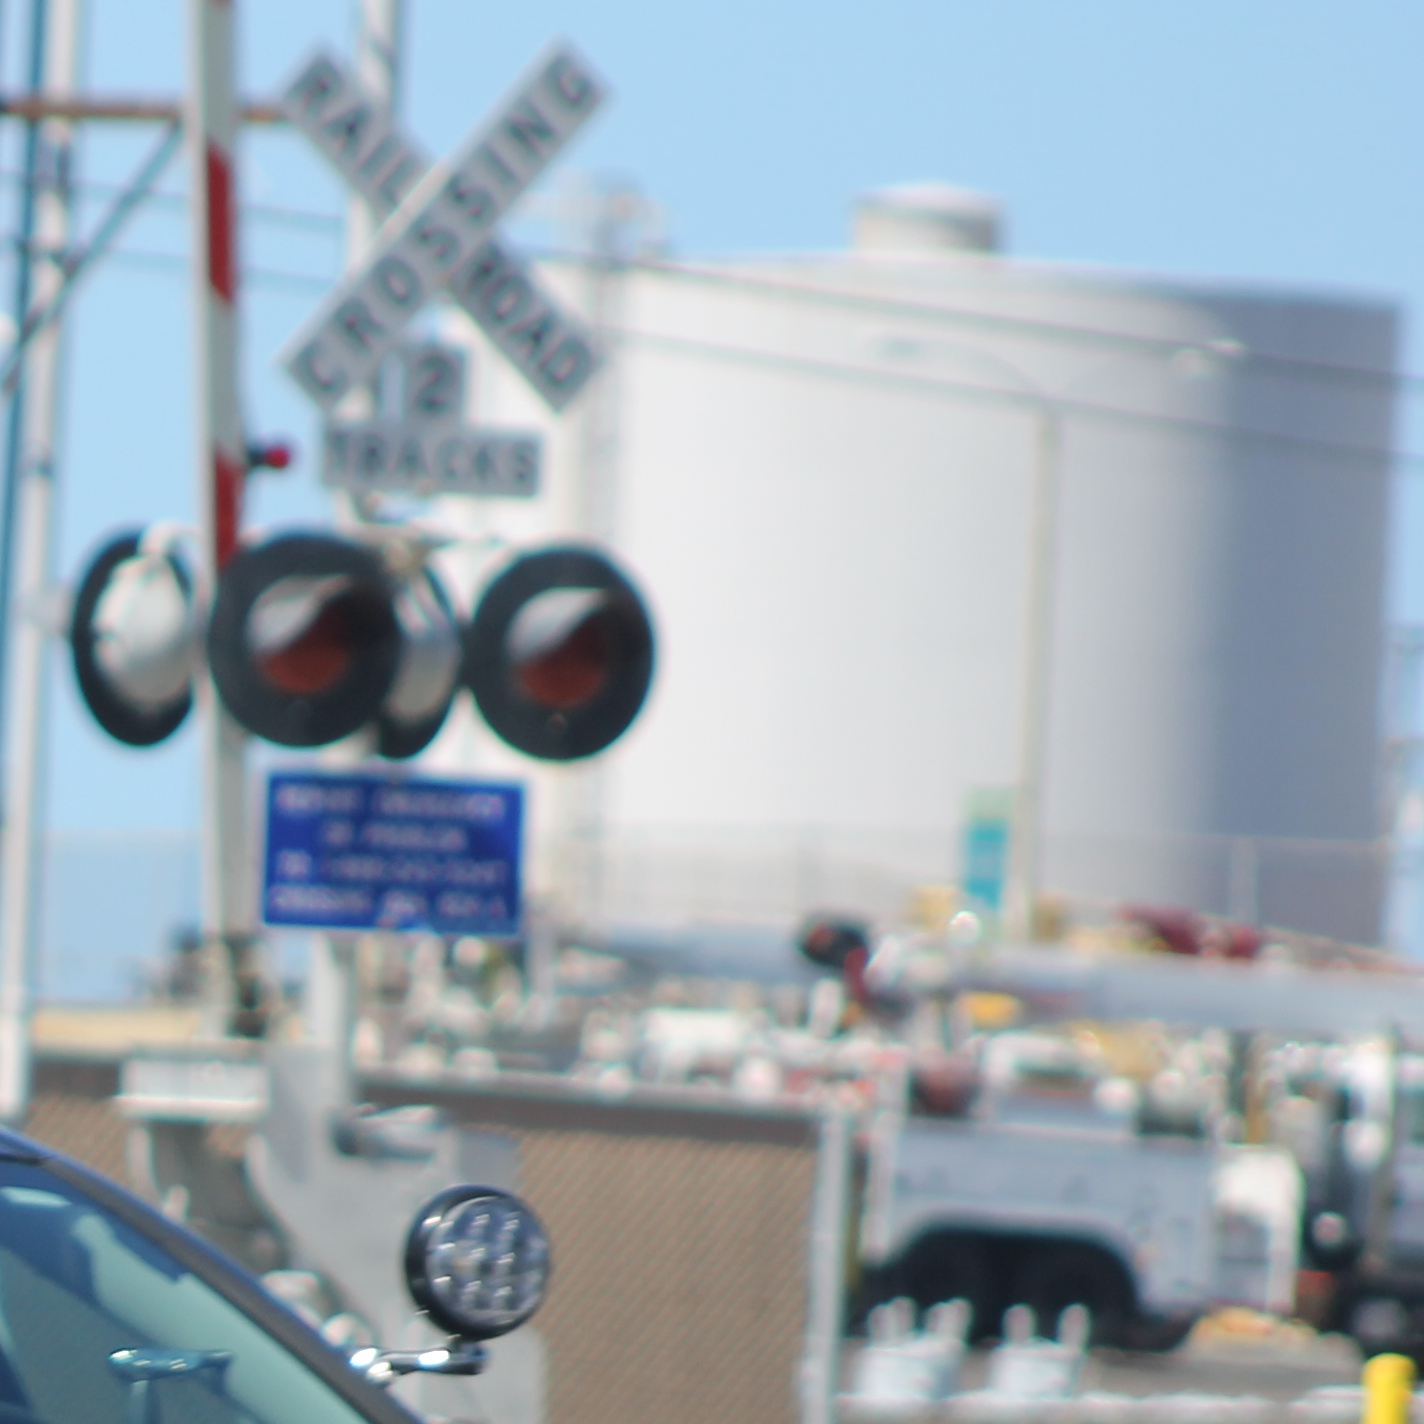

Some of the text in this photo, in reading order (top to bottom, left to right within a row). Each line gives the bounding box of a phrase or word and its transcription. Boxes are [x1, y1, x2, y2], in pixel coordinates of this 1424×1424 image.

[293, 55, 597, 398] CROSSING
[412, 351, 454, 413] 2
[326, 430, 540, 488] TRACKS
